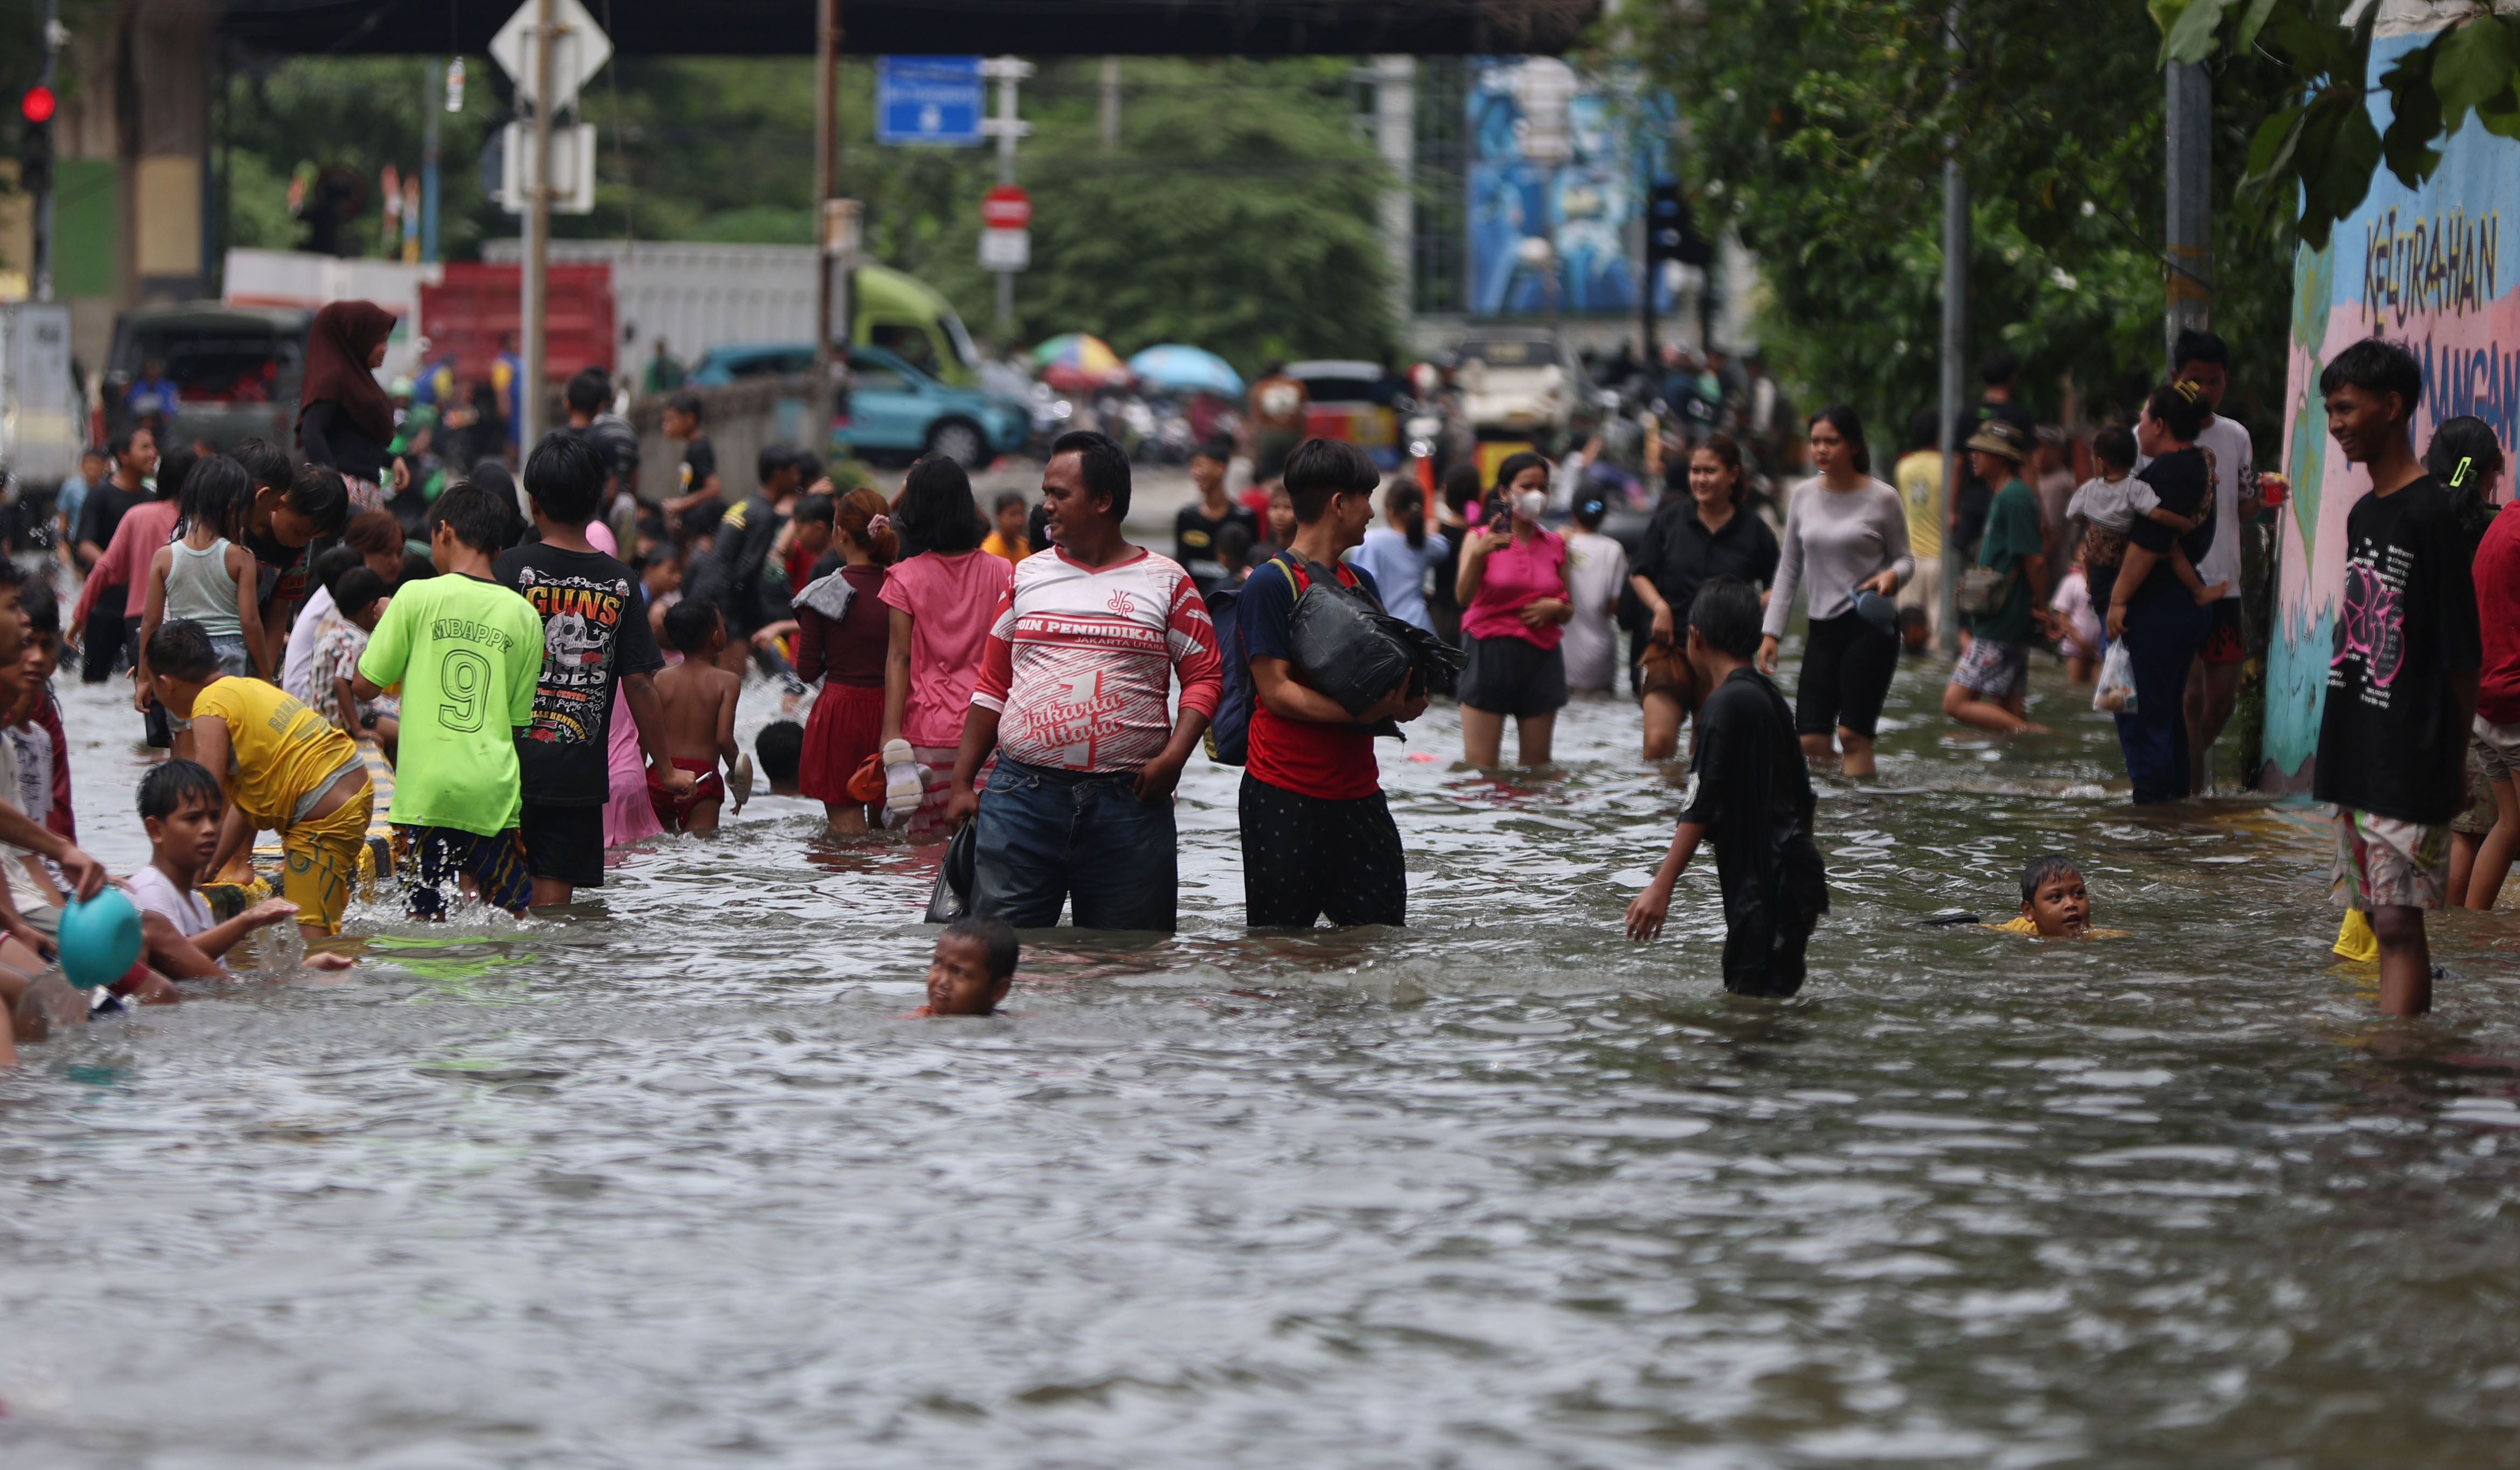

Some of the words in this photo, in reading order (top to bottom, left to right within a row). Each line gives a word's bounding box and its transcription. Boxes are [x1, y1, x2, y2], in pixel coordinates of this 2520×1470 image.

[2362, 206, 2500, 337] KELURAHAN
[2391, 330, 2519, 453] MANGAN
[525, 585, 621, 627] GUNS
[430, 619, 514, 654] MBAPPE
[1046, 621, 1165, 643] PENDIDIKAN
[1074, 636, 1130, 646] JAKARTA
[1133, 641, 1165, 651] UTARA
[537, 660, 608, 685] OSES
[438, 649, 491, 733] 9
[556, 689, 588, 702] CENTER
[1023, 694, 1121, 739] Jakarta
[1033, 718, 1121, 748] Utara
